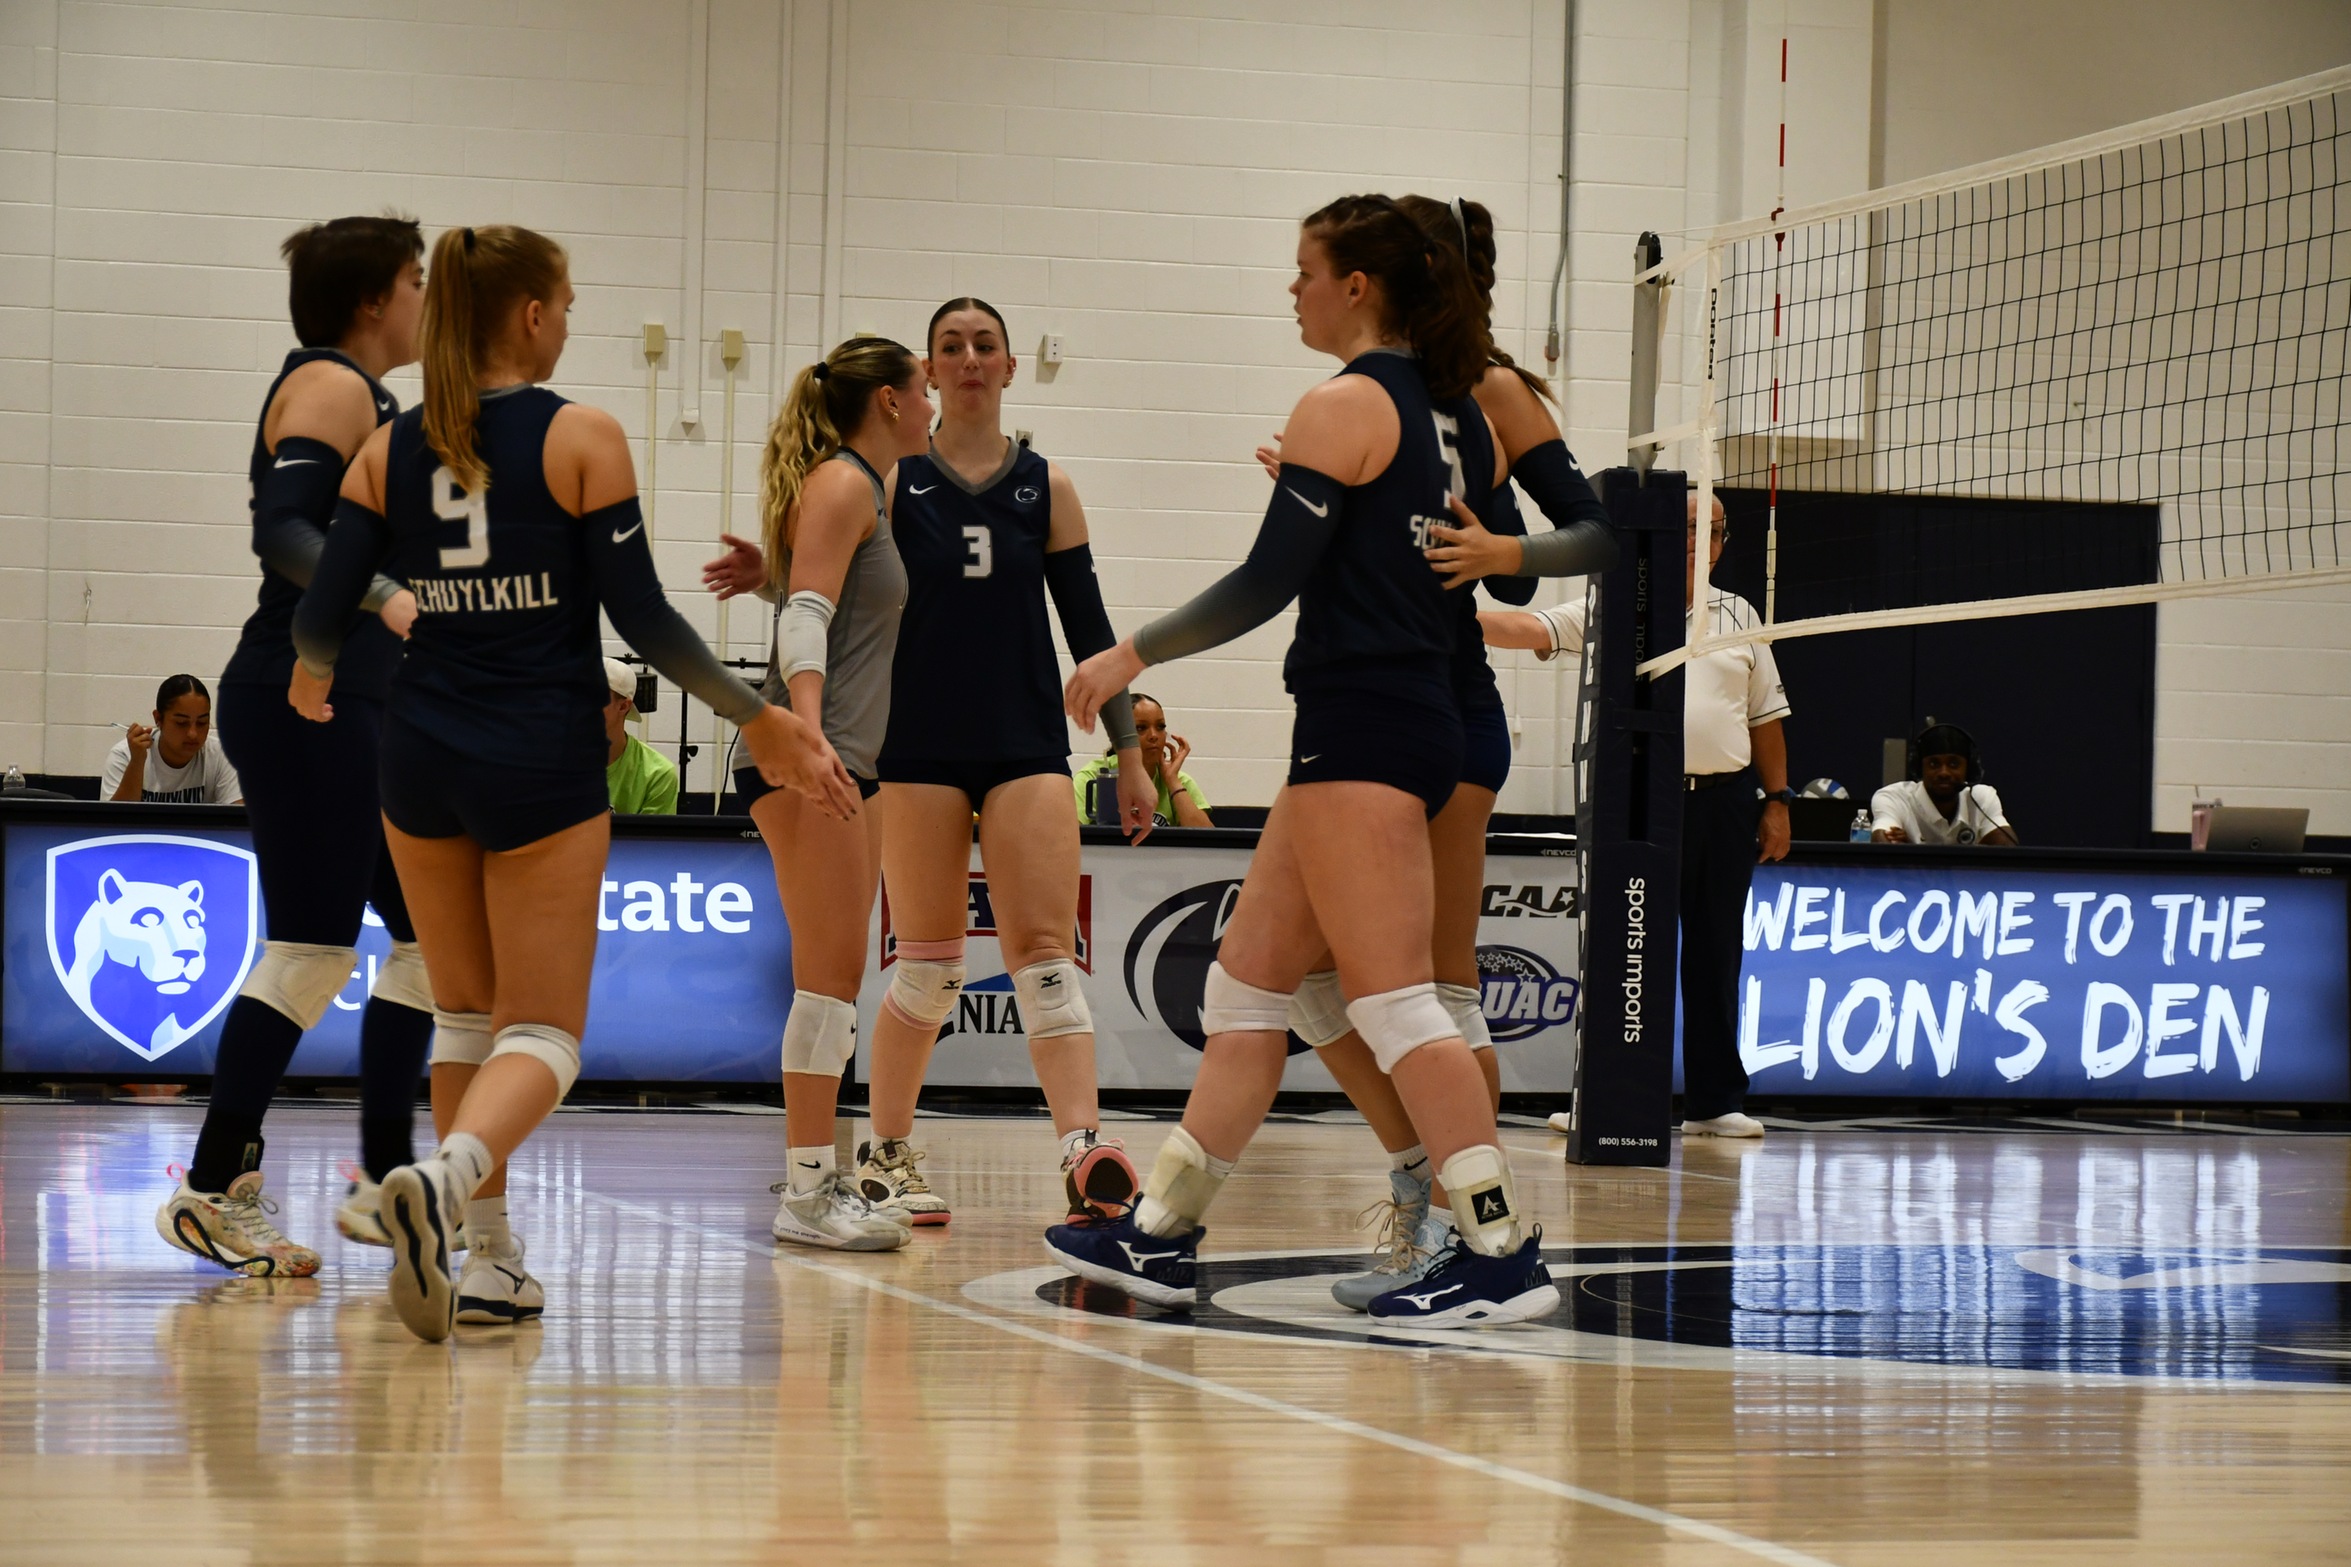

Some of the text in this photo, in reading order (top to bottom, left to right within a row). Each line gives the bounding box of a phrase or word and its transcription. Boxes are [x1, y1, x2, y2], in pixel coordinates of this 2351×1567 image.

[1430, 410, 1467, 509] 5
[431, 464, 491, 570] 9
[961, 525, 993, 579] 3
[1621, 877, 1647, 1043] sports imports
[1742, 881, 2266, 966] WELCOME TO THE
[1738, 967, 2271, 1083] LION'S DEN
[1598, 1136, 1659, 1147] (800) 556-3198
